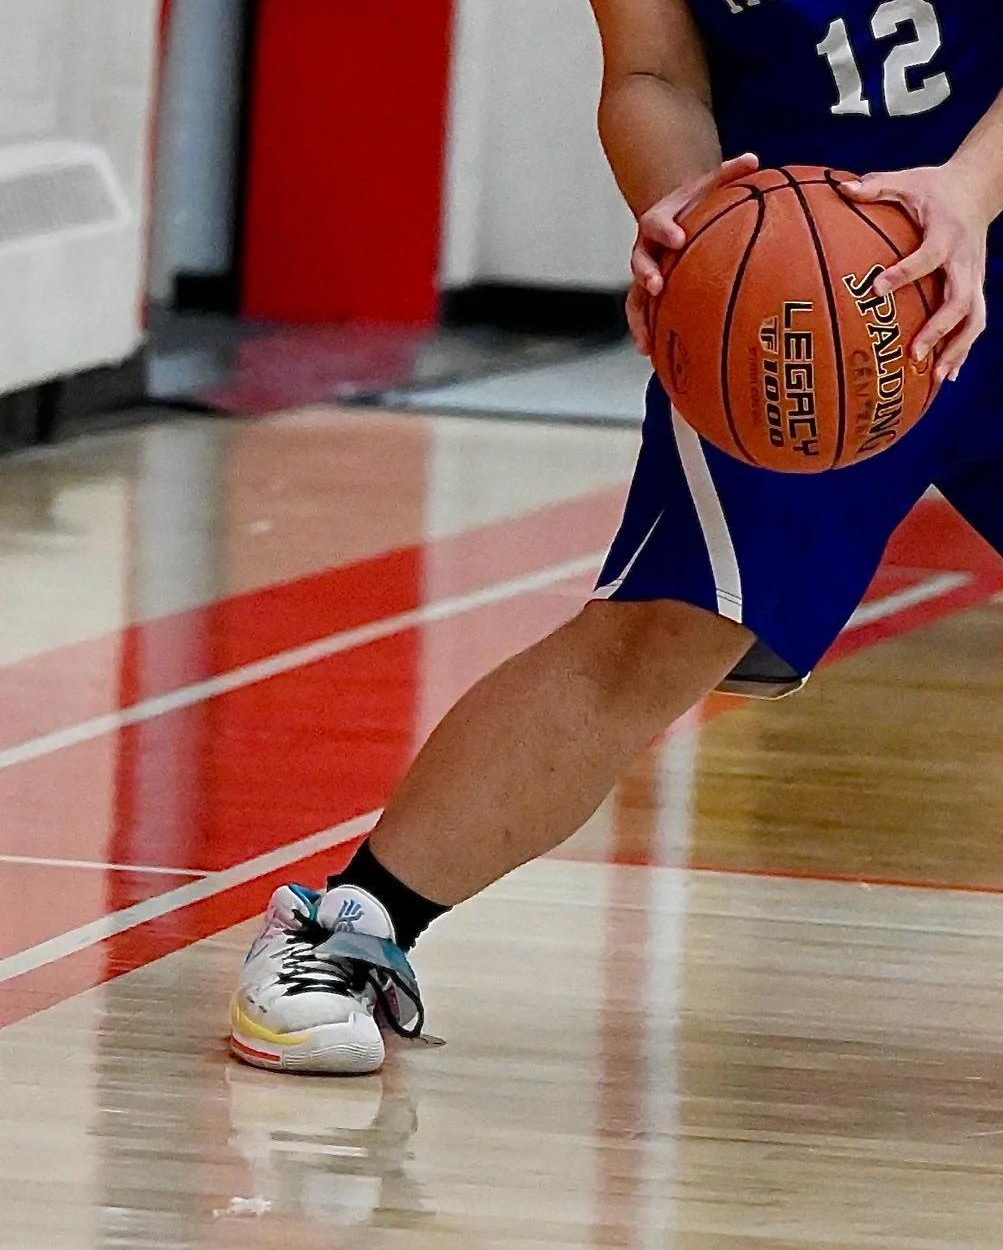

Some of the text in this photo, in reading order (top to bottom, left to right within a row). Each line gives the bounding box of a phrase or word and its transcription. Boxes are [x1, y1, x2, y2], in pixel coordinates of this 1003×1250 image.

[761, 358, 785, 449] 1000
[783, 300, 820, 457] LEGACY
[842, 263, 905, 454] SPALDING
